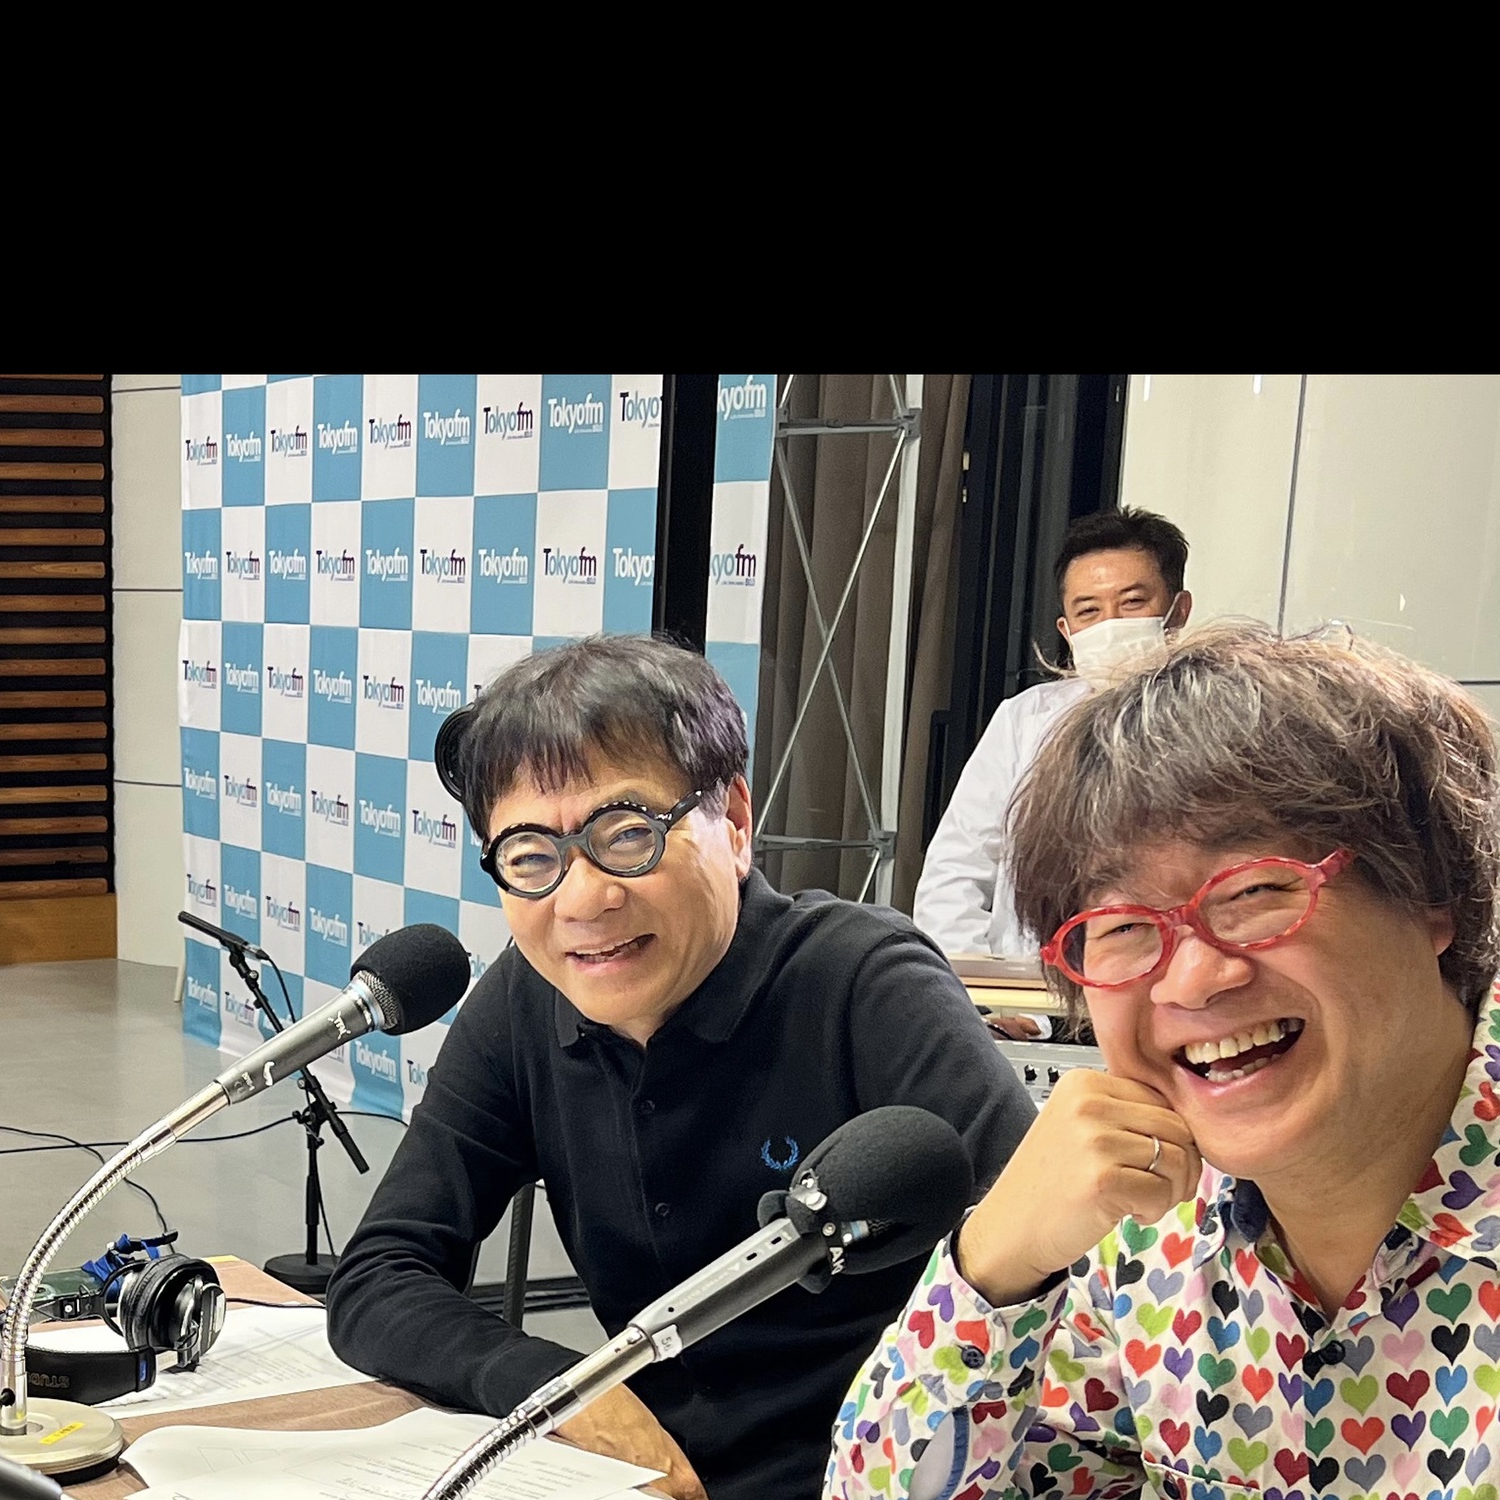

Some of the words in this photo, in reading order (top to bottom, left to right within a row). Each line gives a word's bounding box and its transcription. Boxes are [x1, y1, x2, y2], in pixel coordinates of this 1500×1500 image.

[548, 393, 603, 433] Tokyofm
[620, 391, 661, 428] Tokyo
[717, 376, 766, 421] kyofm
[318, 420, 357, 454] Tokyofm
[369, 414, 411, 449] Tokyofm
[423, 408, 470, 445] Tokyofm
[483, 402, 533, 439] Tokyofm
[186, 437, 217, 465] Tokyofm
[226, 431, 261, 462] Tokyofm
[271, 425, 307, 458] Tokyofm
[185, 550, 218, 580] Tokyofm
[226, 551, 260, 580] Tokyofm
[269, 549, 306, 580] Tokyofm
[316, 550, 355, 581] Tokyofm
[366, 547, 408, 582] Tokyofm
[420, 549, 466, 583] Tokyofm
[478, 547, 528, 584] Tokyofm
[543, 547, 597, 584] Tokyofm
[613, 548, 655, 586] Tokyo
[183, 660, 217, 689] Tokyofm
[225, 663, 259, 692] Tokyofm
[267, 667, 304, 697] Tokyofm
[313, 670, 352, 703] Tokyofm
[363, 675, 405, 709] Tokyofm
[415, 679, 462, 713] Tokyofm
[184, 767, 217, 798] Tokyofm
[224, 775, 257, 806] Tokyofm
[266, 782, 302, 815] Tokyofm
[311, 790, 349, 824] Tokyofm
[359, 800, 400, 836] Tokyofm
[412, 810, 457, 846] Tokyofm
